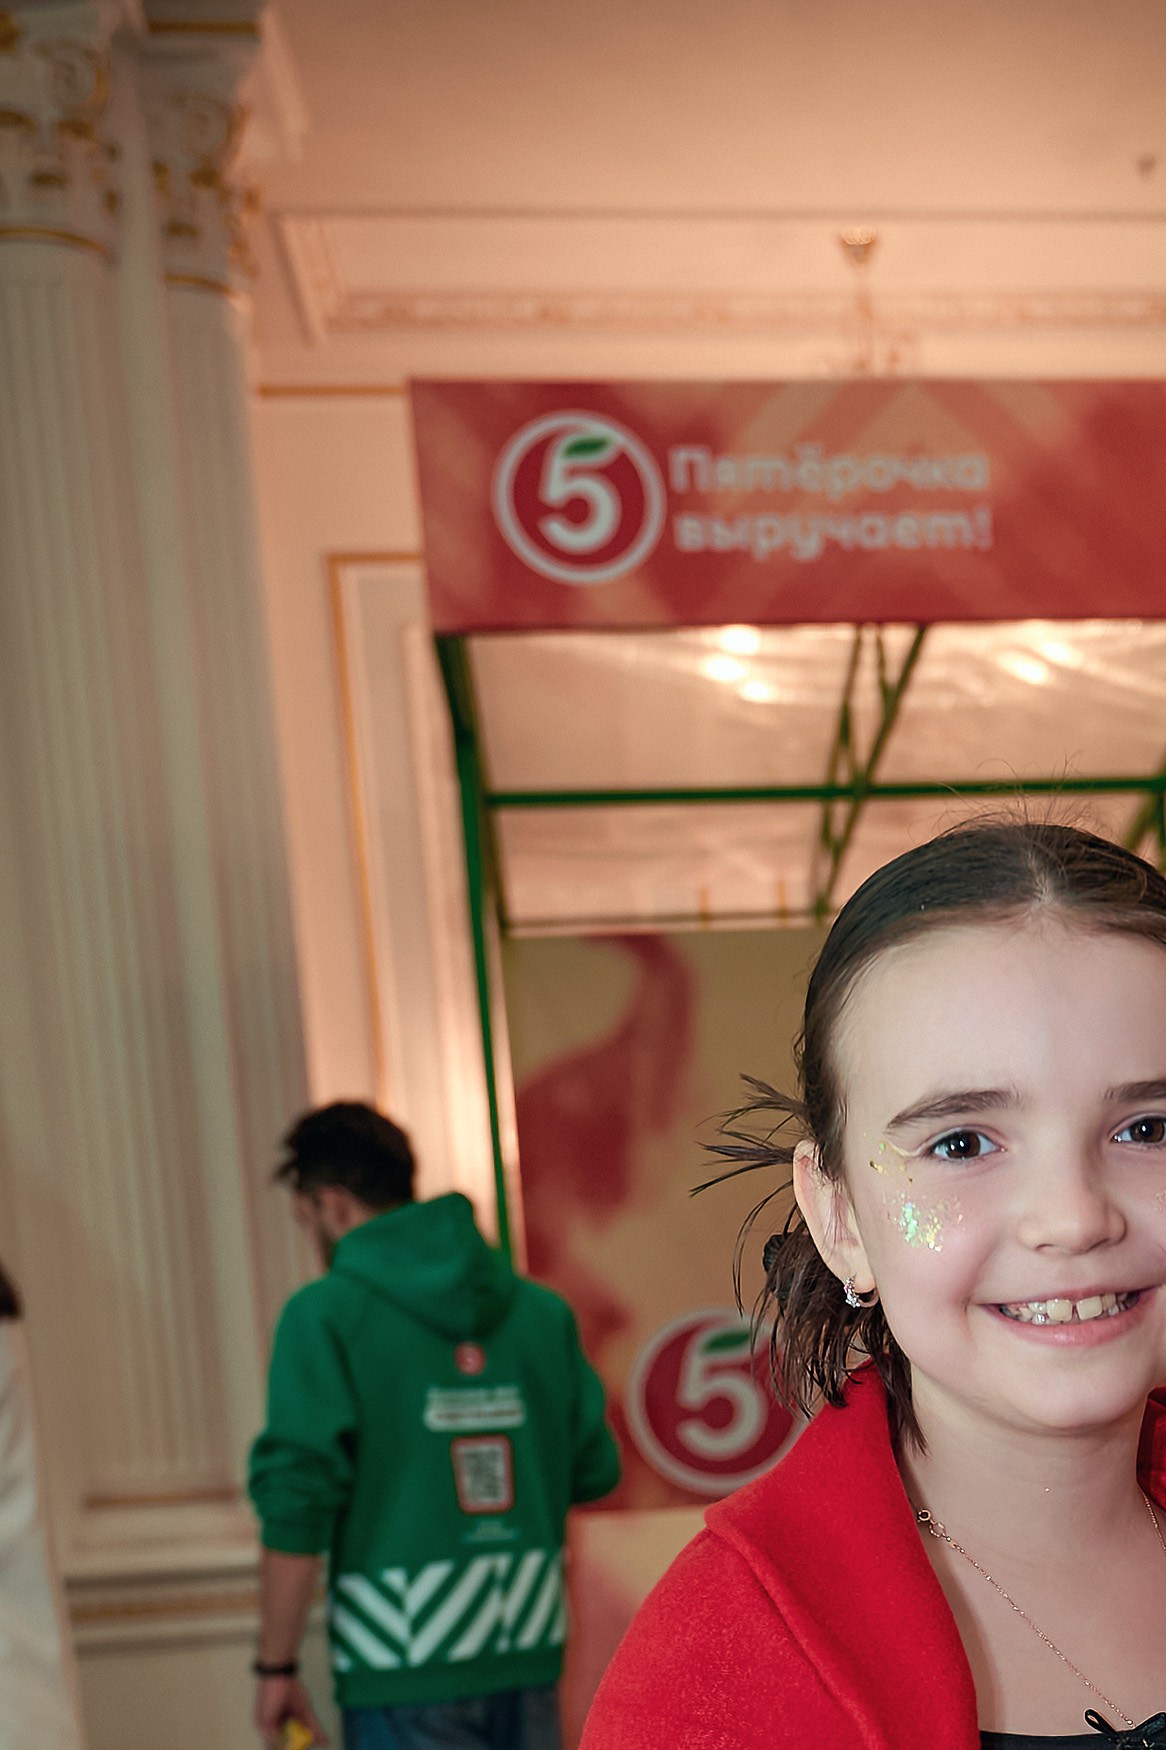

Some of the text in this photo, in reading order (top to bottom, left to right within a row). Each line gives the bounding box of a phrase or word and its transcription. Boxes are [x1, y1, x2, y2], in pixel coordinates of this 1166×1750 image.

[538, 425, 622, 551] 5
[673, 446, 989, 499] Пятёрочка
[676, 508, 991, 560] выручает!
[676, 1320, 766, 1460] 5
